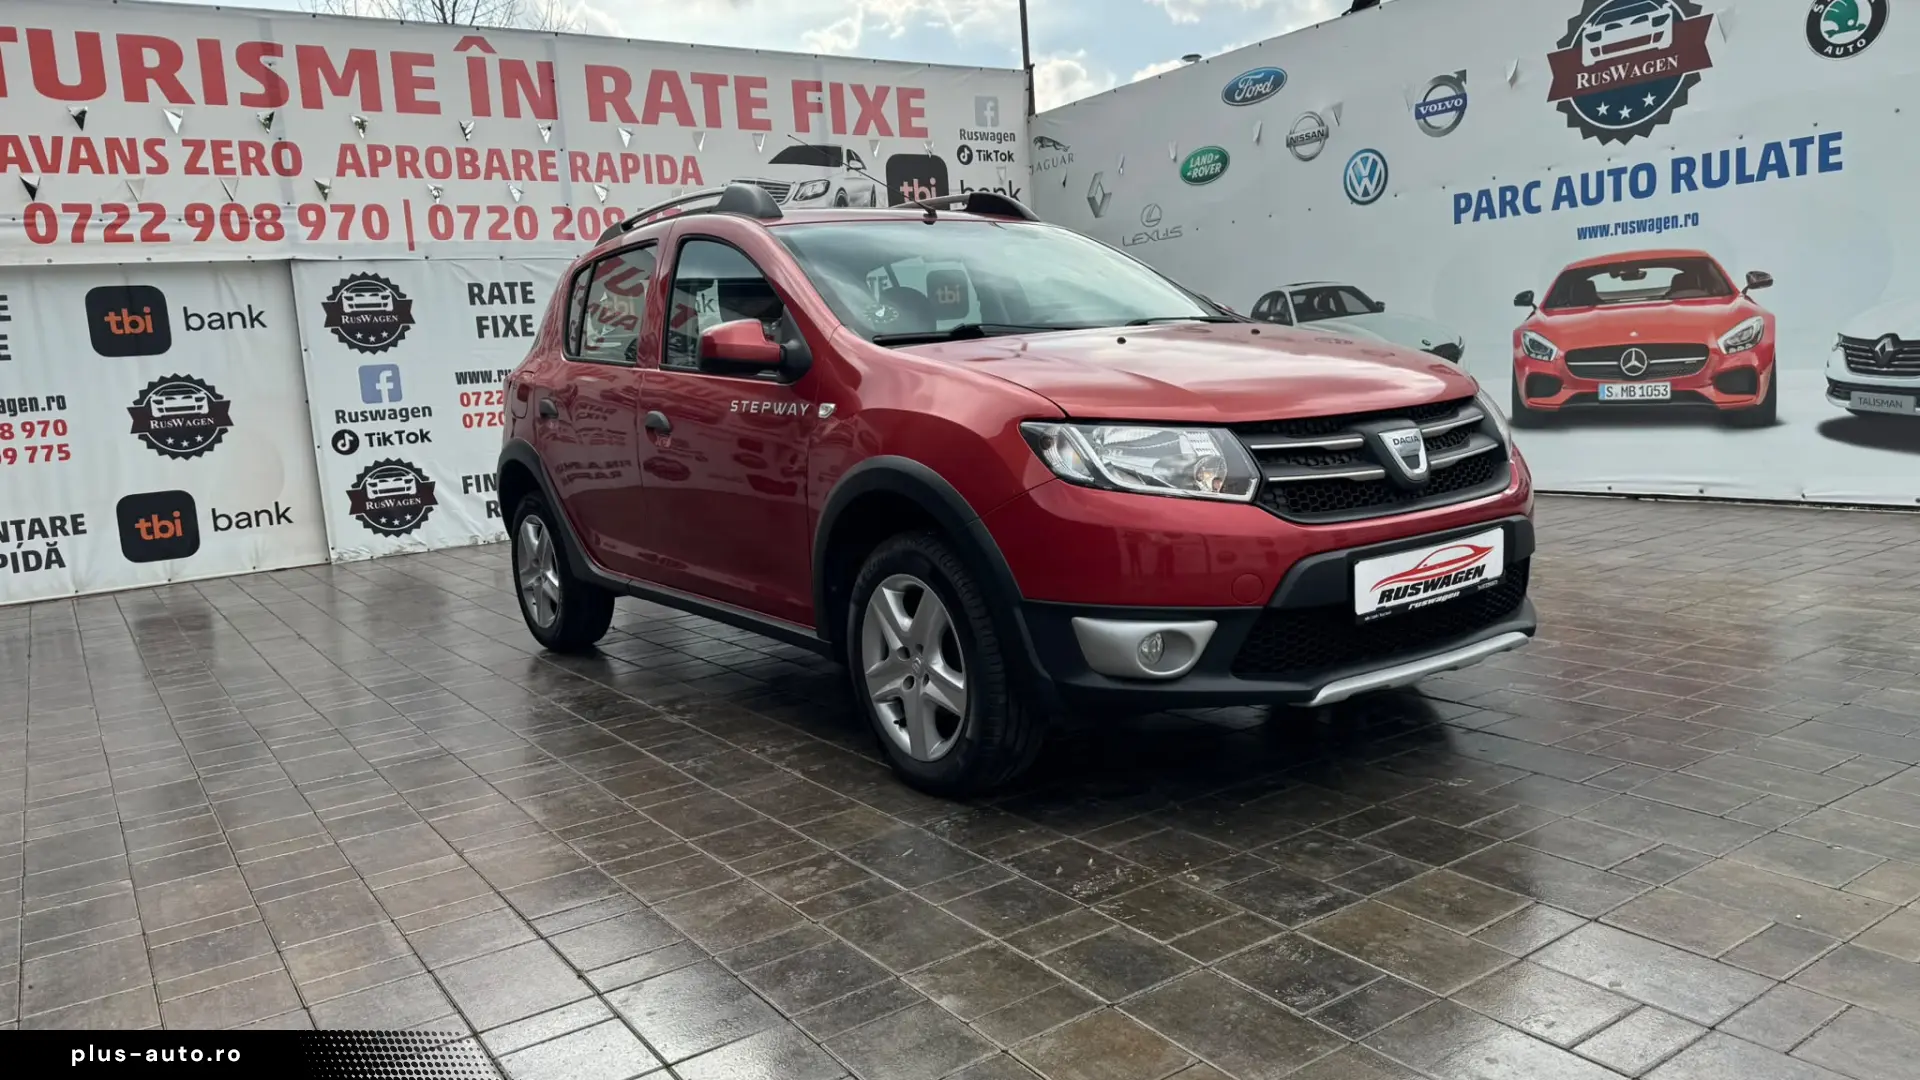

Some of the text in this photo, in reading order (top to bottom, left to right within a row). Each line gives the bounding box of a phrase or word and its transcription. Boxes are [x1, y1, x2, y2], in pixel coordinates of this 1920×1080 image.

[1823, 38, 1866, 55] AUTO
[453, 35, 558, 120] ÎN
[584, 64, 772, 131] RATE
[791, 80, 929, 138] FIXE
[1234, 72, 1274, 100] Ford
[1419, 98, 1463, 115] VOLVO
[959, 128, 1016, 144] Ruswagen
[1289, 129, 1325, 145] NISSAN
[0, 135, 704, 186] AVANS ZERO APROBARE RAPIDA
[975, 149, 1015, 163] TikTok
[1029, 153, 1074, 176] JAGUAR
[1189, 153, 1214, 168] LAND
[1191, 163, 1222, 178] ROVER
[1453, 131, 1843, 225] PARC AUTO RULATE
[23, 203, 171, 244] 0722
[184, 203, 285, 242] 908
[298, 203, 390, 241] 970
[427, 204, 538, 241] 0720
[1577, 212, 1699, 240] www.ruswagen.ro
[1122, 225, 1183, 247] LEXUS
[467, 281, 536, 306] RATE
[104, 304, 267, 335] tbi bank
[475, 314, 535, 339] FIXE
[1621, 385, 1637, 398] MB
[1638, 384, 1669, 398] 1053
[730, 400, 810, 416] STEPWAY
[1858, 396, 1903, 409] TALISMAN
[335, 405, 433, 425] Ruswagen
[21, 419, 68, 439] 970
[365, 429, 432, 448] TikTok
[1392, 435, 1419, 446] DACIA
[24, 443, 71, 464] 775
[134, 501, 293, 541] tbi bank
[1377, 564, 1486, 605] RUSWAGEN
[1408, 591, 1461, 610] ruswagen
